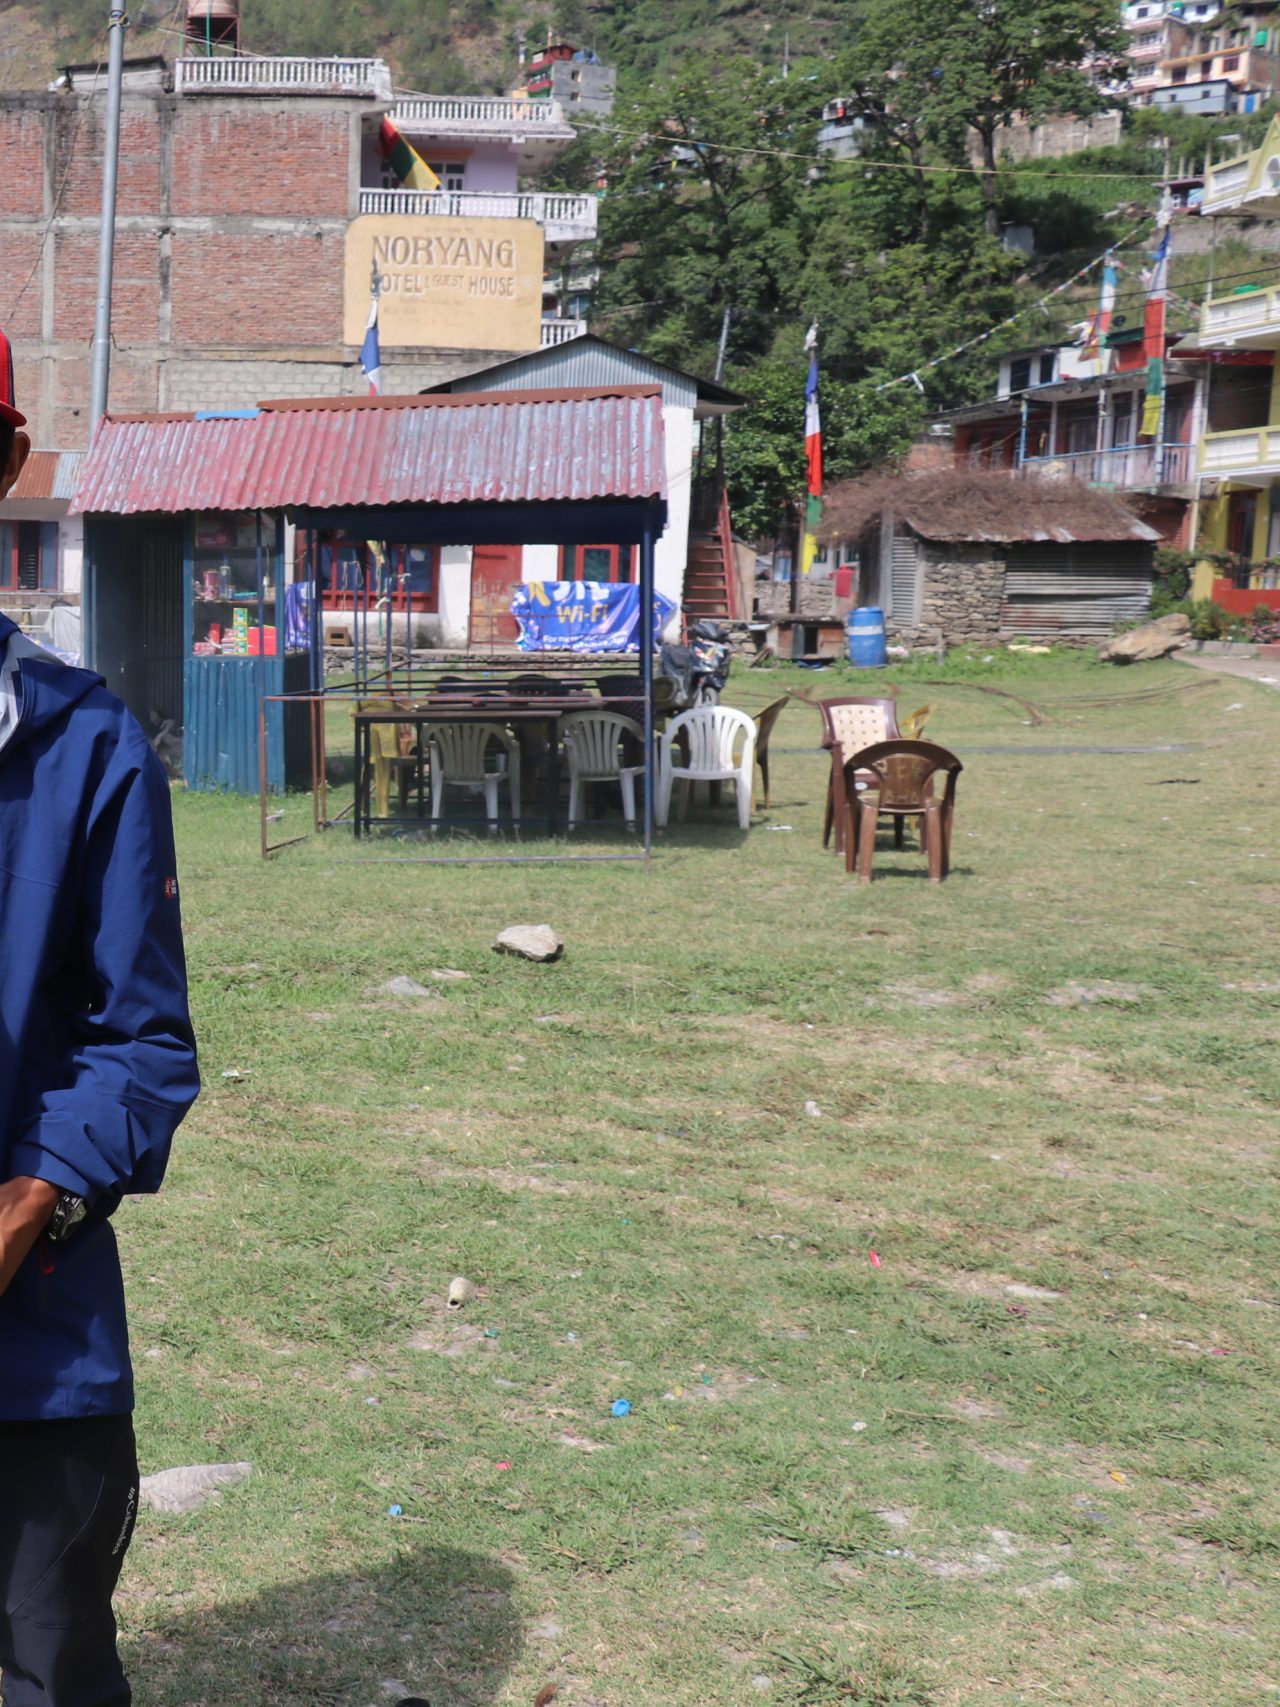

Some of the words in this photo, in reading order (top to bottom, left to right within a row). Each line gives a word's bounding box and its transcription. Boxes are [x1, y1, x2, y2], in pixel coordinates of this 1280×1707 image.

[372, 235, 515, 268] NORYANG
[371, 272, 424, 294] OTEL
[432, 274, 465, 290] GUEST
[469, 276, 515, 297] HOUSE
[557, 604, 608, 623] Wi-Fi
[112, 1500, 135, 1555] Columbia
